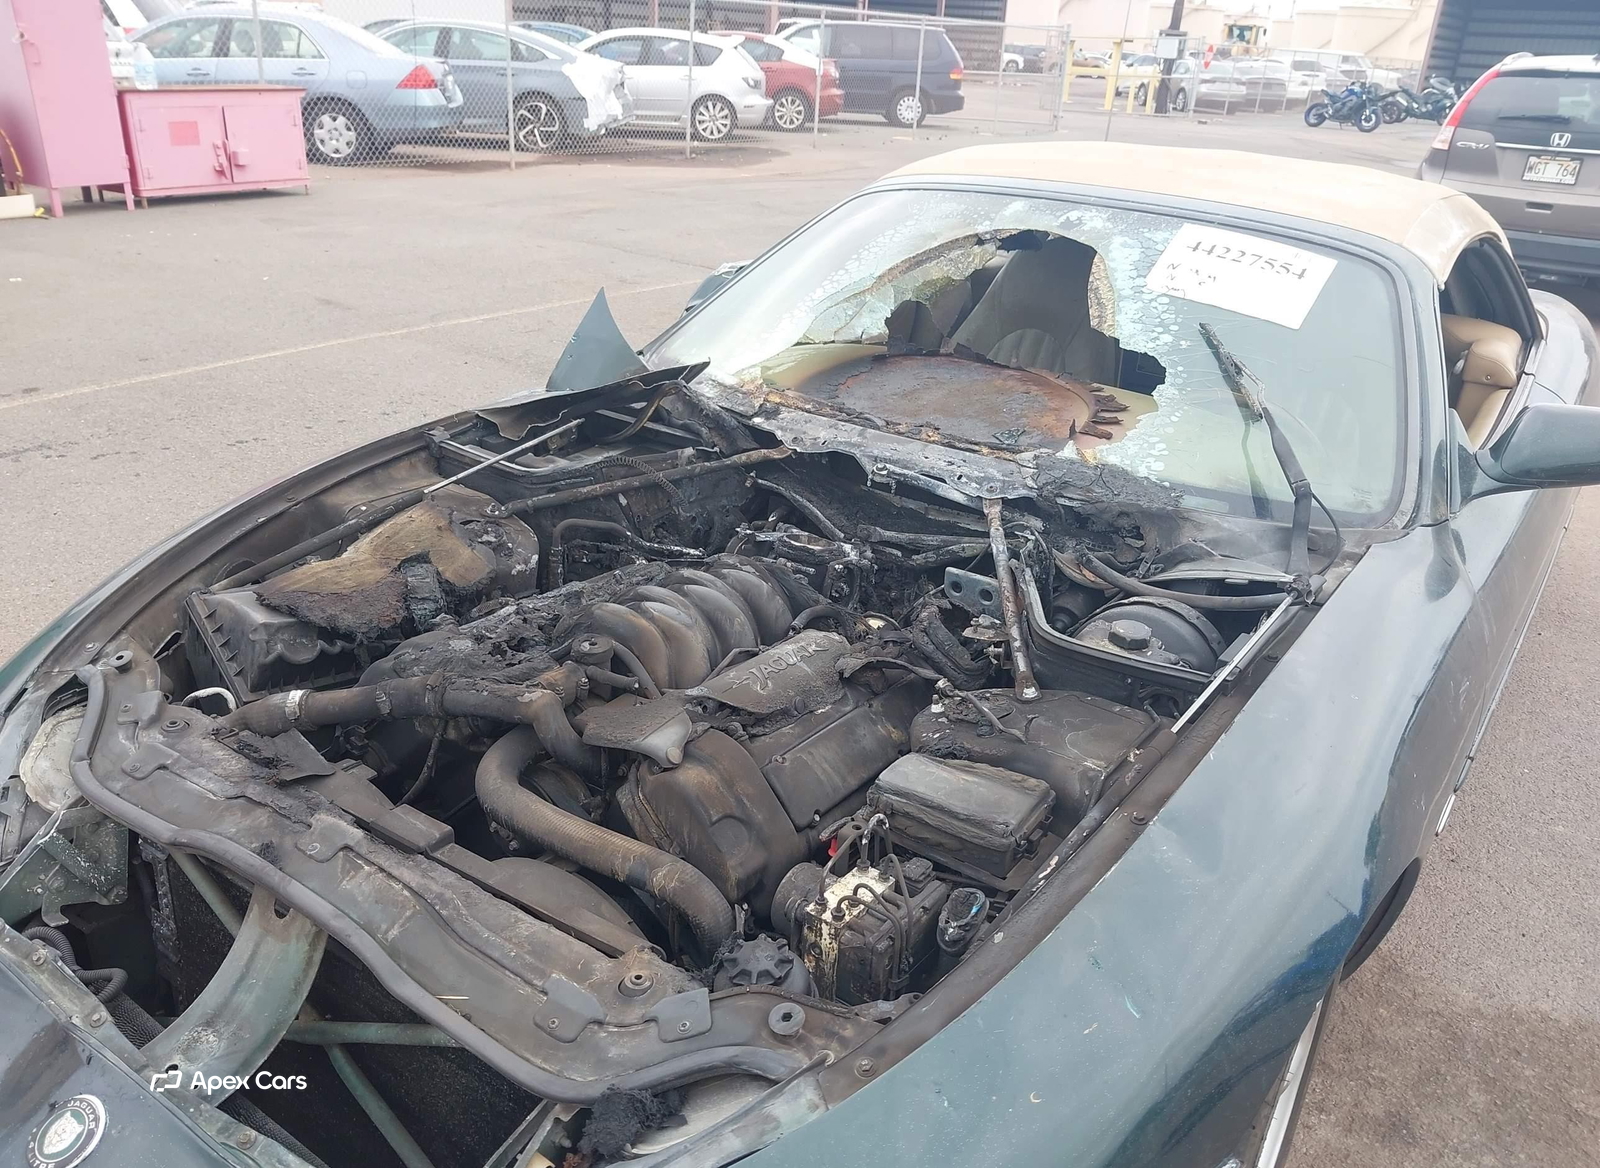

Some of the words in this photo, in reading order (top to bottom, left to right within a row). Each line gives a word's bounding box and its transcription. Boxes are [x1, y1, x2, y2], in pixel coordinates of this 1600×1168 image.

[1526, 160, 1550, 176] WGT
[1555, 163, 1578, 178] 764
[749, 641, 830, 692] JAGUAR
[67, 1100, 97, 1130] JAGUAR
